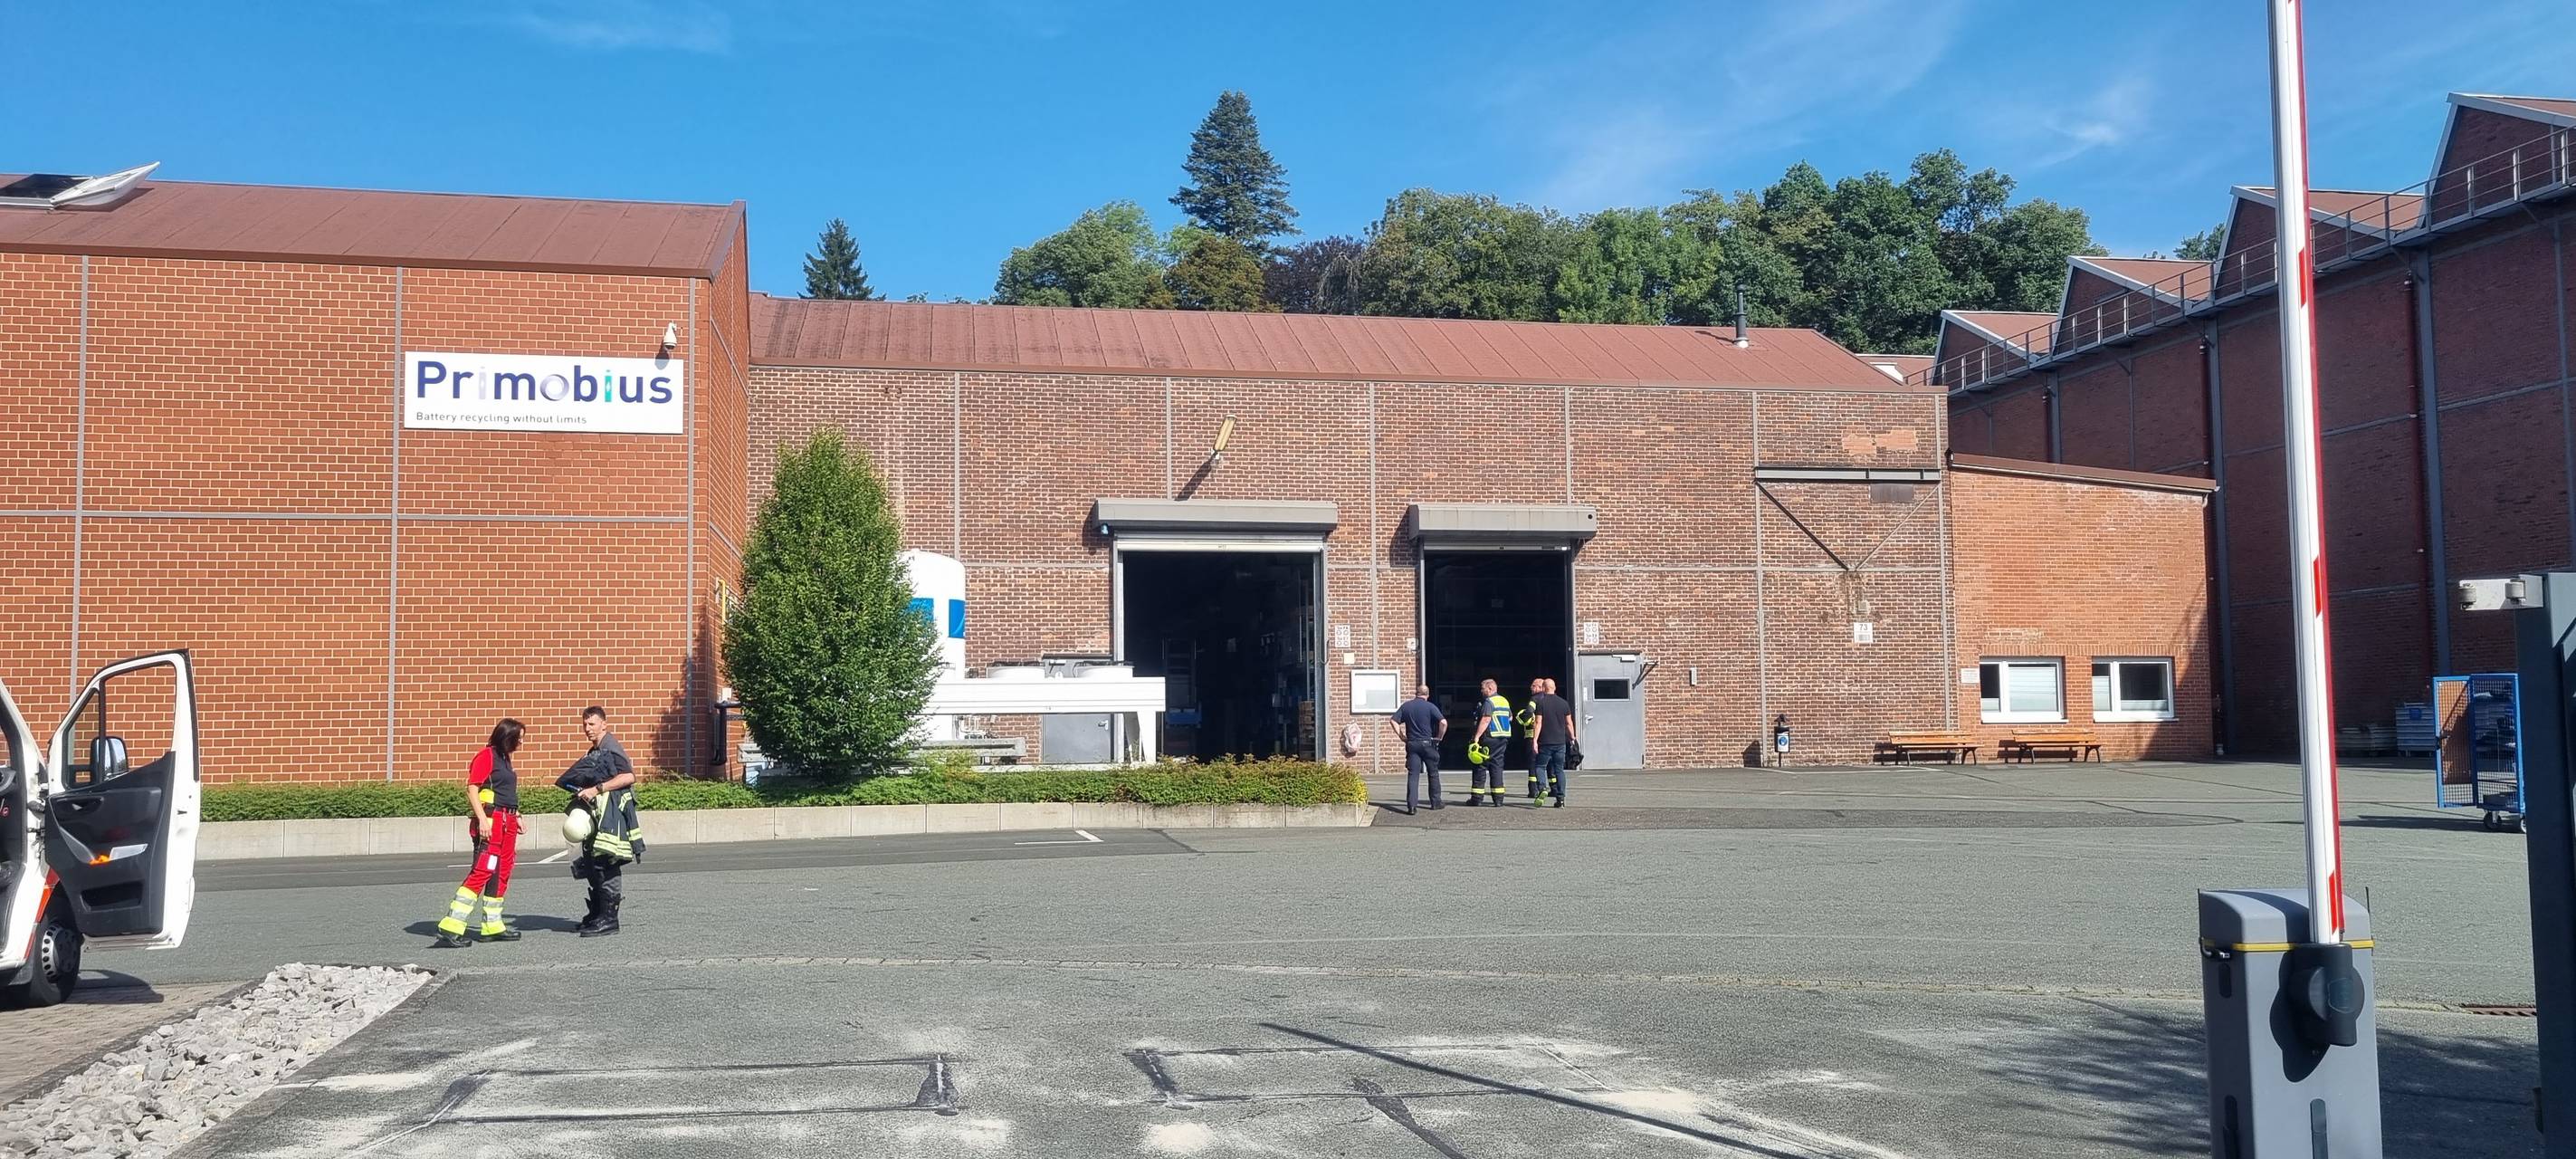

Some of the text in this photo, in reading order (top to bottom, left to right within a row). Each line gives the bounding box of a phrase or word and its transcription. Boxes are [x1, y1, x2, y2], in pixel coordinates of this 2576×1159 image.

[416, 360, 673, 404] Primobius
[416, 411, 587, 425] Battery recycling without limits
